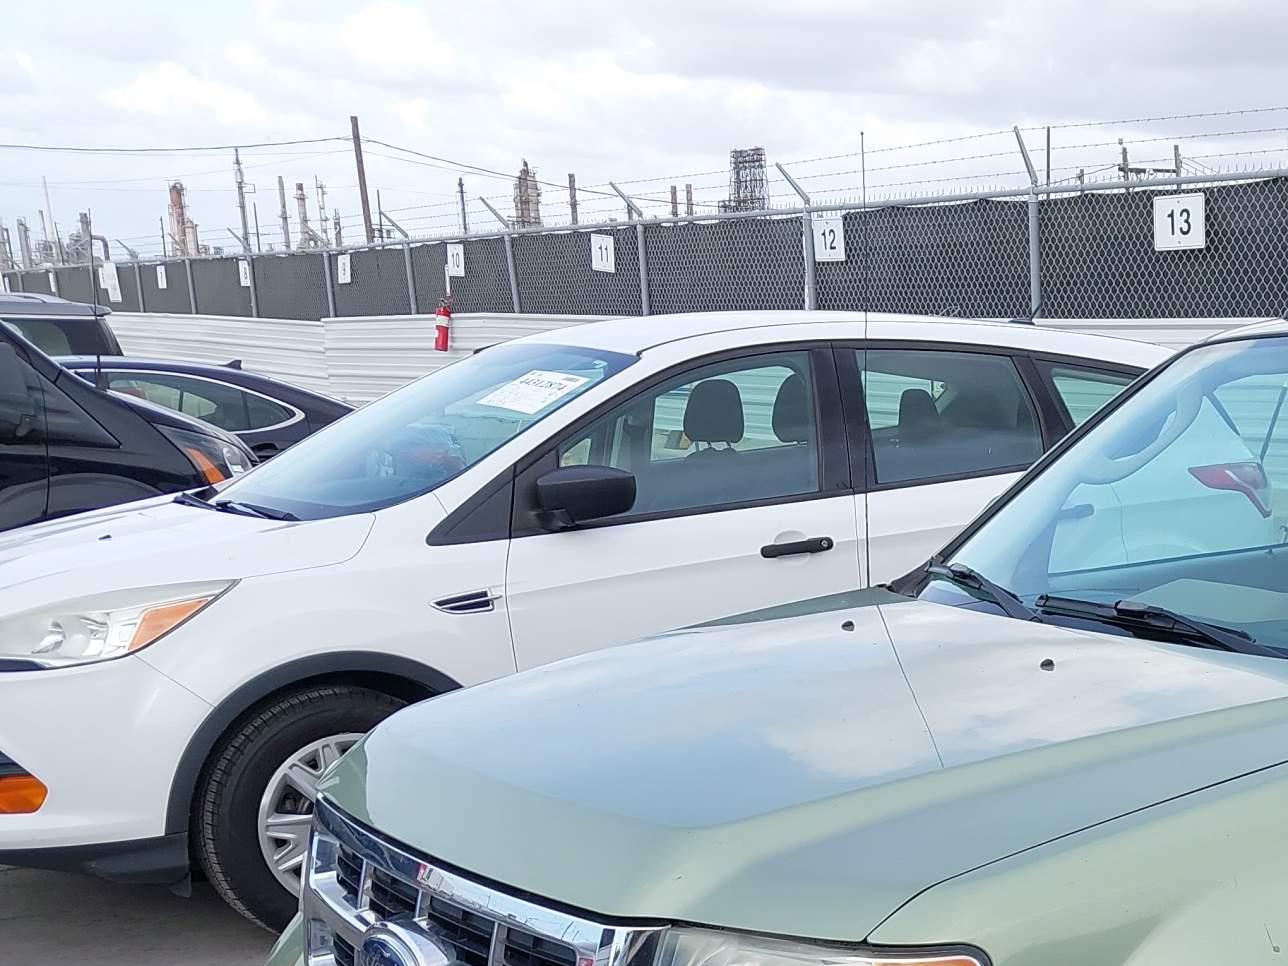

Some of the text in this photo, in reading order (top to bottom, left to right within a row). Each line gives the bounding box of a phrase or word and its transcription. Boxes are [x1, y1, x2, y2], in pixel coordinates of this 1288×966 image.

[1166, 208, 1192, 237] 13
[821, 229, 837, 251] 12
[451, 252, 461, 269] 10
[598, 244, 609, 263] 11
